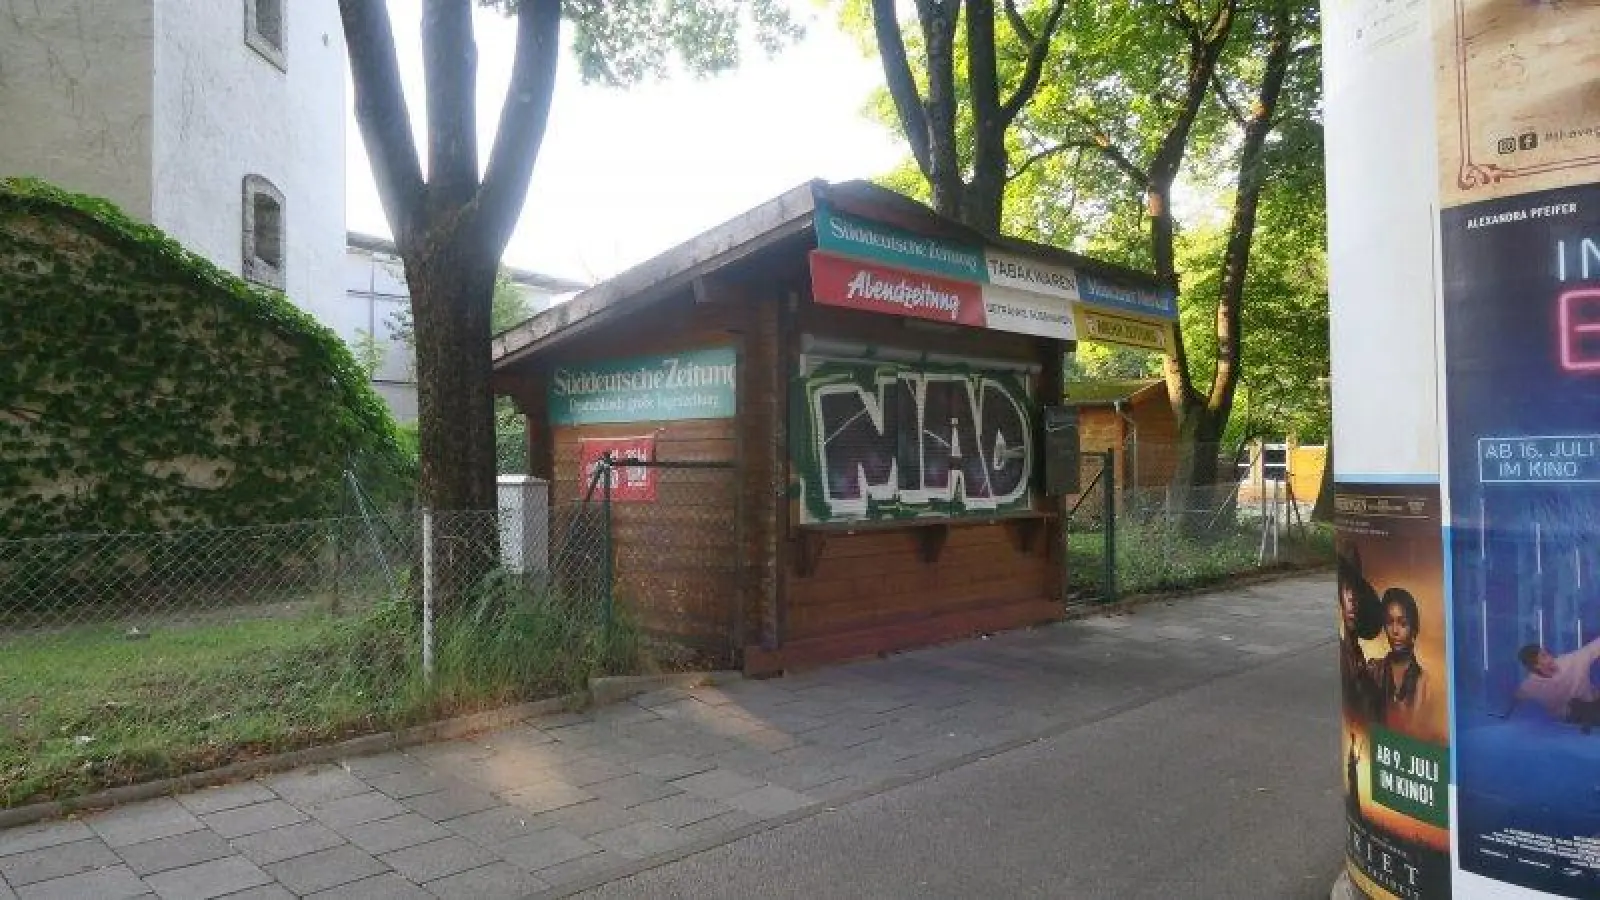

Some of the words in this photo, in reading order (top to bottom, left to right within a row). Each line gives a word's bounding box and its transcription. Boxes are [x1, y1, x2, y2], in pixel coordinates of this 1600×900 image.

[1467, 209, 1528, 230] ALEXANDRA
[1530, 203, 1577, 218] PFEIFER
[987, 259, 1075, 290] TABAKWAREN
[847, 268, 959, 320] Abendzeitung
[553, 367, 664, 396] Süddeutsche
[663, 358, 735, 390] Zeitung
[1485, 443, 1513, 459] AB
[1518, 442, 1543, 459] 16.
[1549, 441, 1595, 457] JULI
[1499, 461, 1521, 477] IM
[1529, 461, 1577, 477] KINO
[1376, 743, 1391, 767] AB
[1393, 749, 1405, 773] 9.
[1407, 755, 1439, 782] JULI
[1379, 769, 1393, 791] IM
[1395, 774, 1434, 807] KINO!
